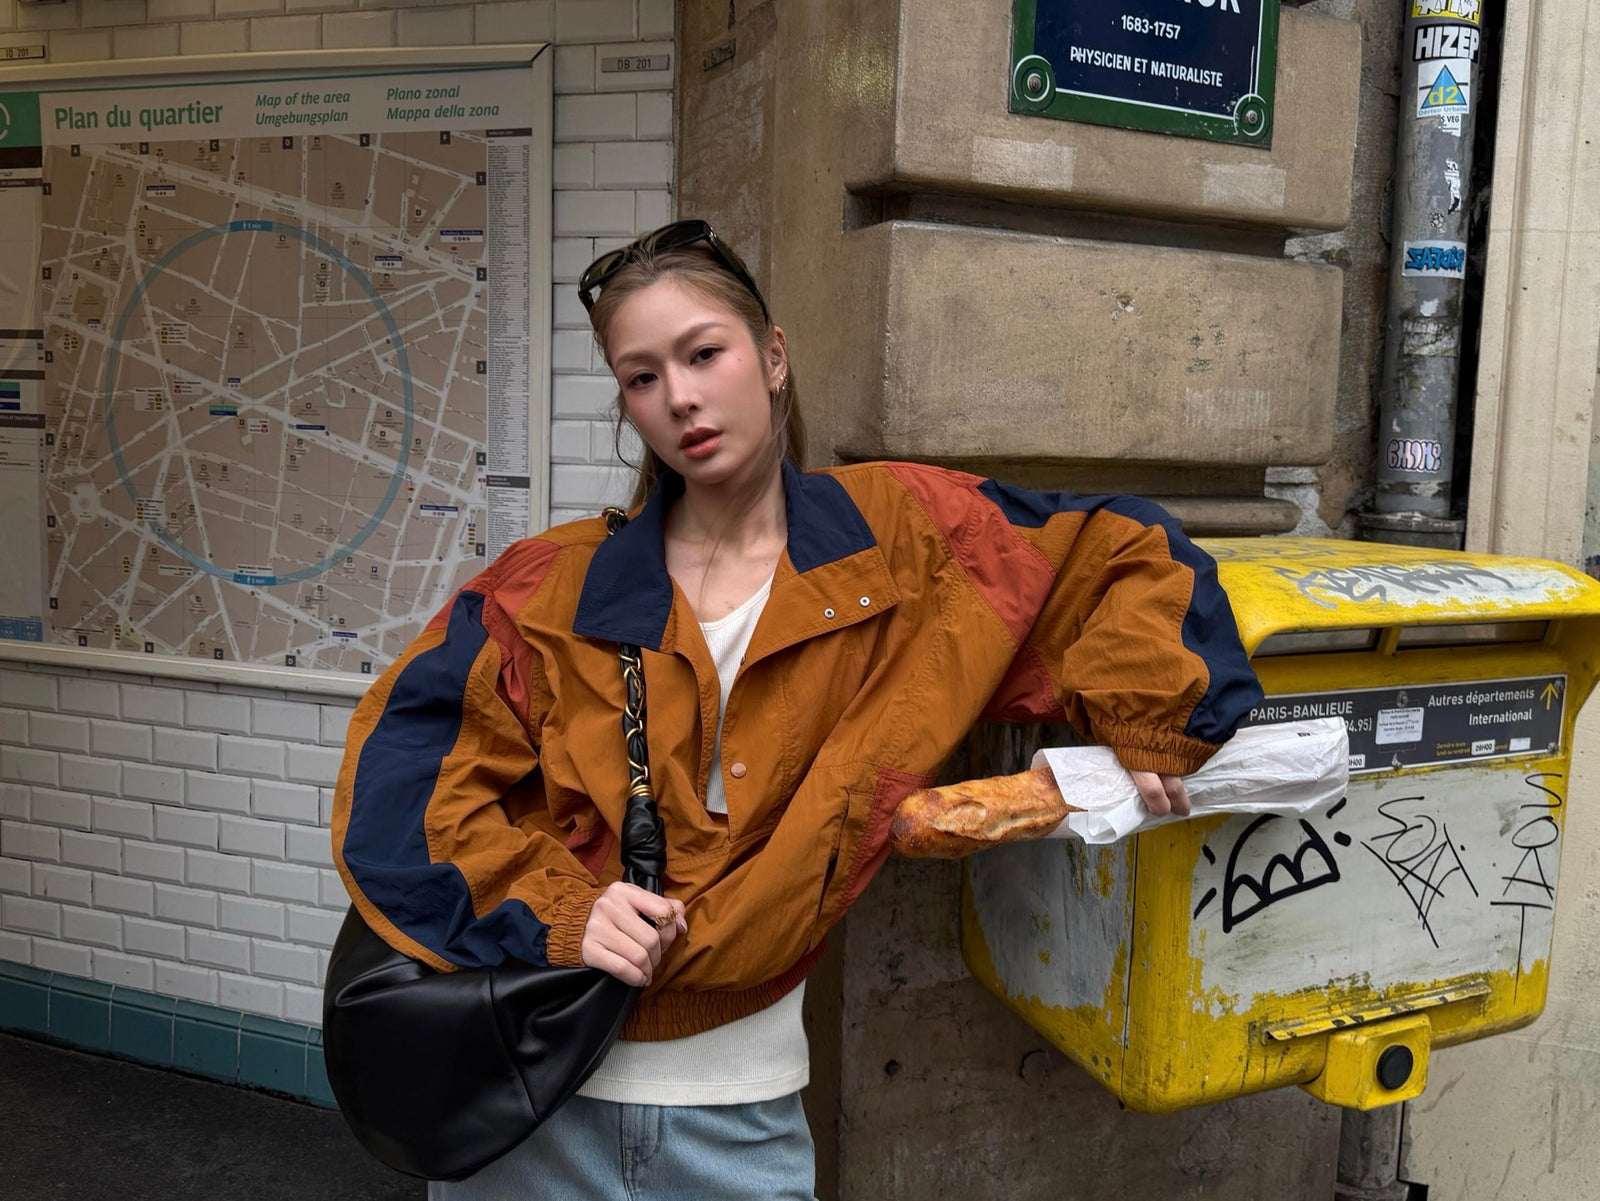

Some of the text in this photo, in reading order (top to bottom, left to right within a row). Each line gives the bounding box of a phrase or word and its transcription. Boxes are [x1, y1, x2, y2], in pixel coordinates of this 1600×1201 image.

[1121, 14, 1181, 40] 1683-1757
[636, 58, 651, 69] 201
[1070, 46, 1223, 88] PHYSICIEN ET NATURALISTE
[255, 92, 351, 109] Map of the area
[386, 84, 461, 101] Plano zonal
[1429, 85, 1459, 106] d2
[54, 100, 223, 132] Plan du quartier
[255, 109, 349, 128] Umgebungsplan
[386, 103, 500, 123] Mappa della zona
[1446, 115, 1460, 123] VEG
[1428, 687, 1535, 707] Autres départements
[1249, 701, 1354, 722] PARIS-BANLIEUE
[1468, 708, 1533, 726] International
